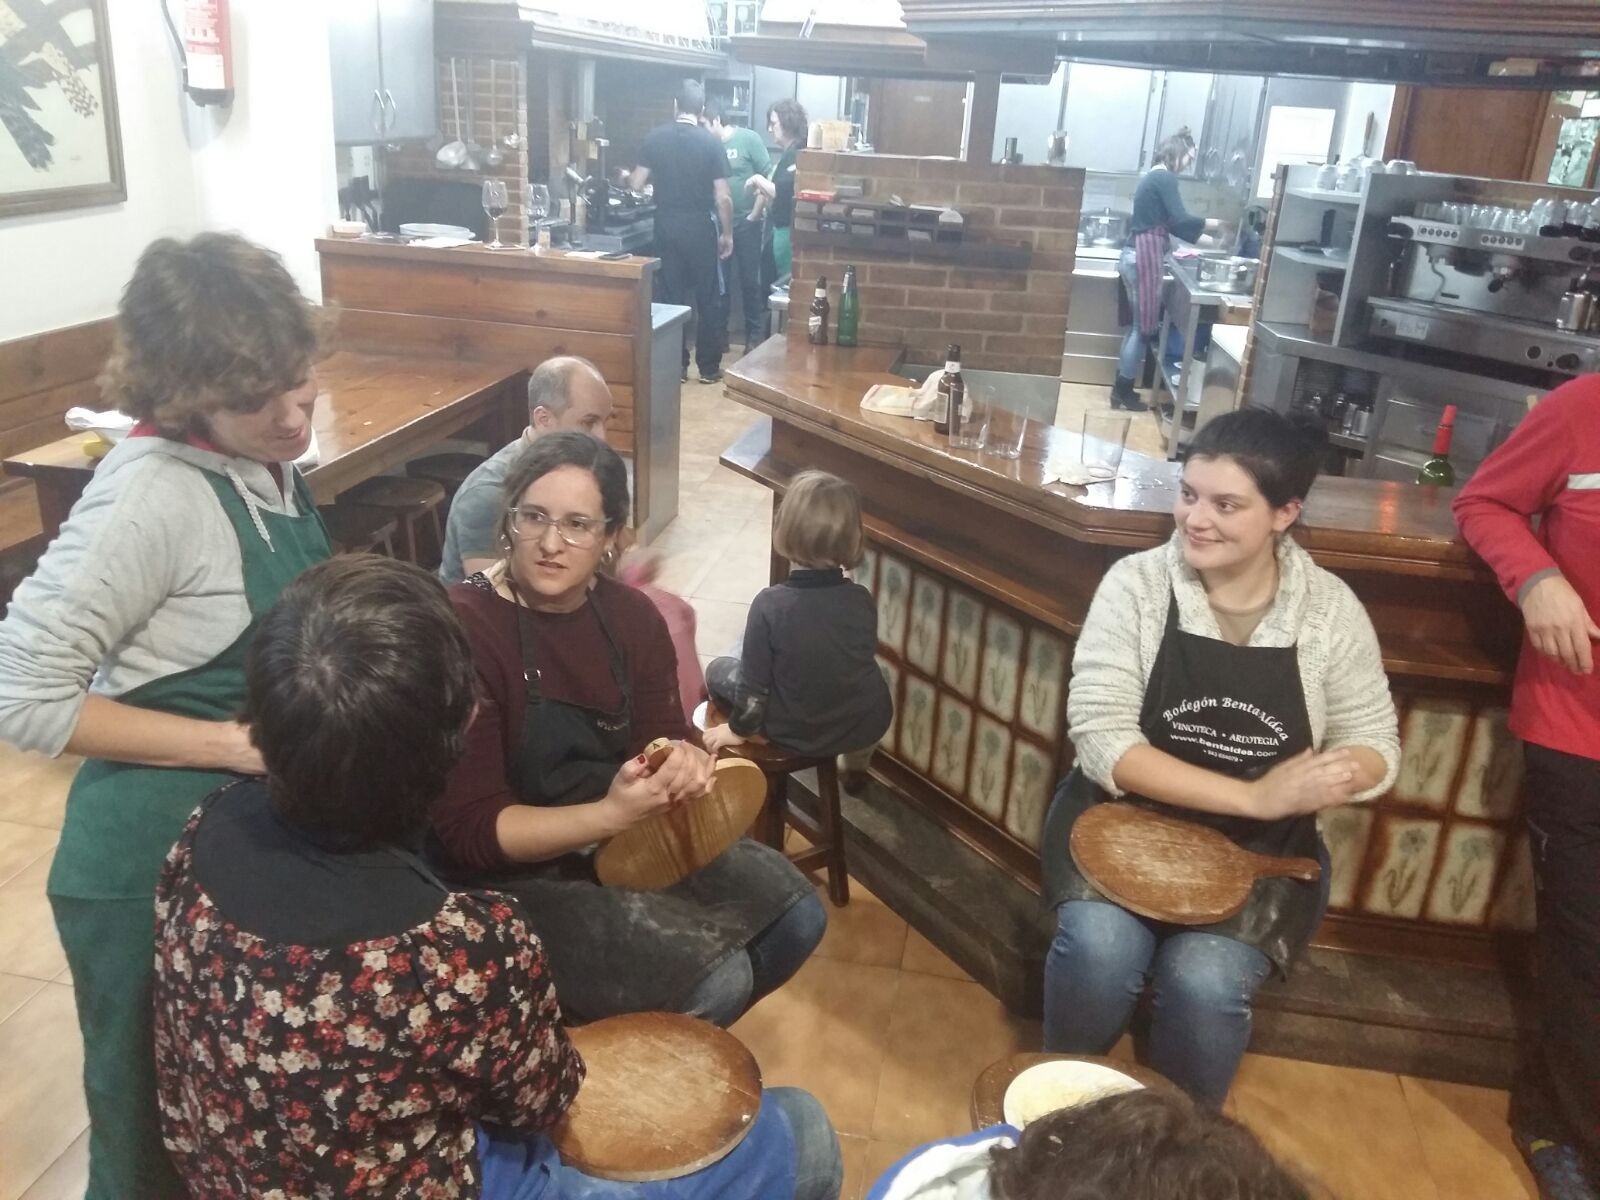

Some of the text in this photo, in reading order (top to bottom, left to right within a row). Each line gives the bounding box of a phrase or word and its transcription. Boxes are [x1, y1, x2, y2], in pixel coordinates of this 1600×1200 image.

[1163, 697, 1218, 721] Bodegón
[1172, 721, 1217, 738] VINOTECA
[1170, 734, 1277, 757] www.bentaldea.com
